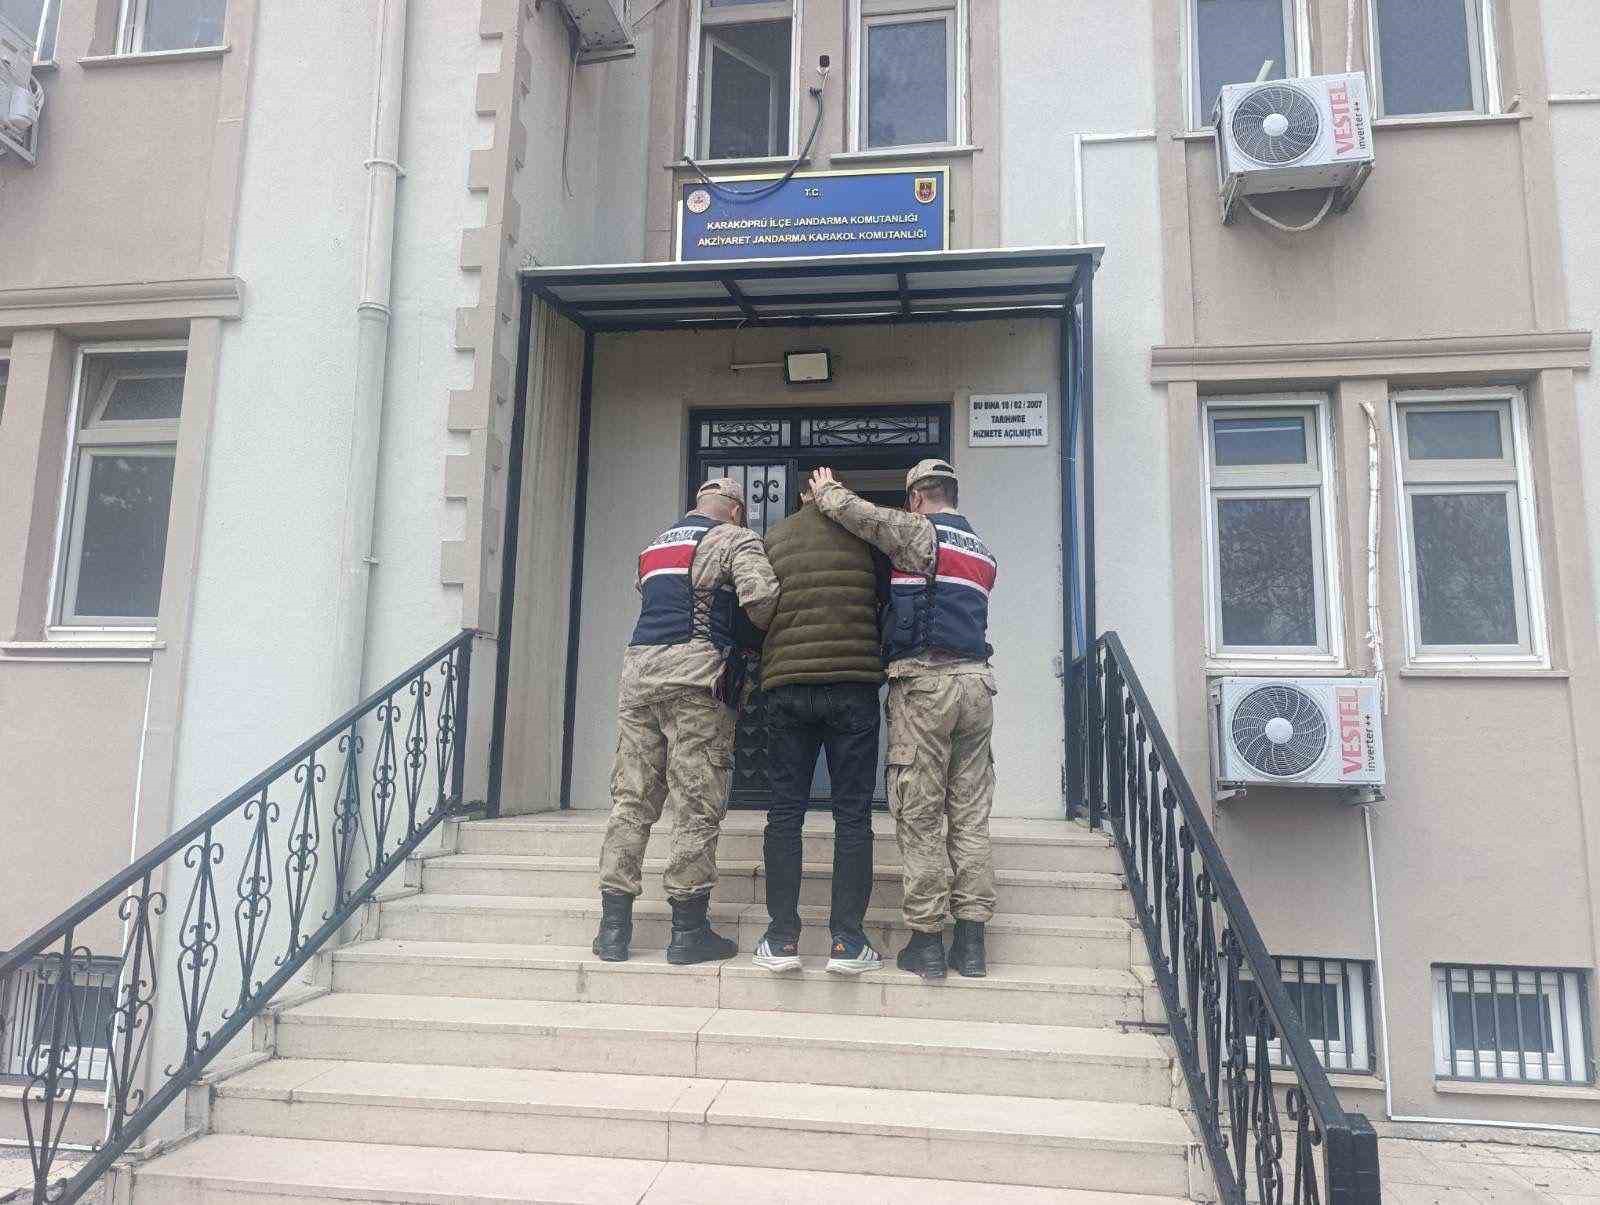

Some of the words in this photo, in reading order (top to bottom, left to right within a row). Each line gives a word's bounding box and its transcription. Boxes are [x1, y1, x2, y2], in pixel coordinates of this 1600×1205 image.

[1328, 80, 1354, 155] VESTEL
[752, 233, 807, 244] JANDARMA
[808, 232, 857, 242] KARAKOL
[858, 228, 927, 240] KOMUTANLIĞI
[793, 216, 849, 227] JANDARMA
[850, 212, 918, 224] KOMUTANLIĞI
[1339, 687, 1361, 775] VESTEL
